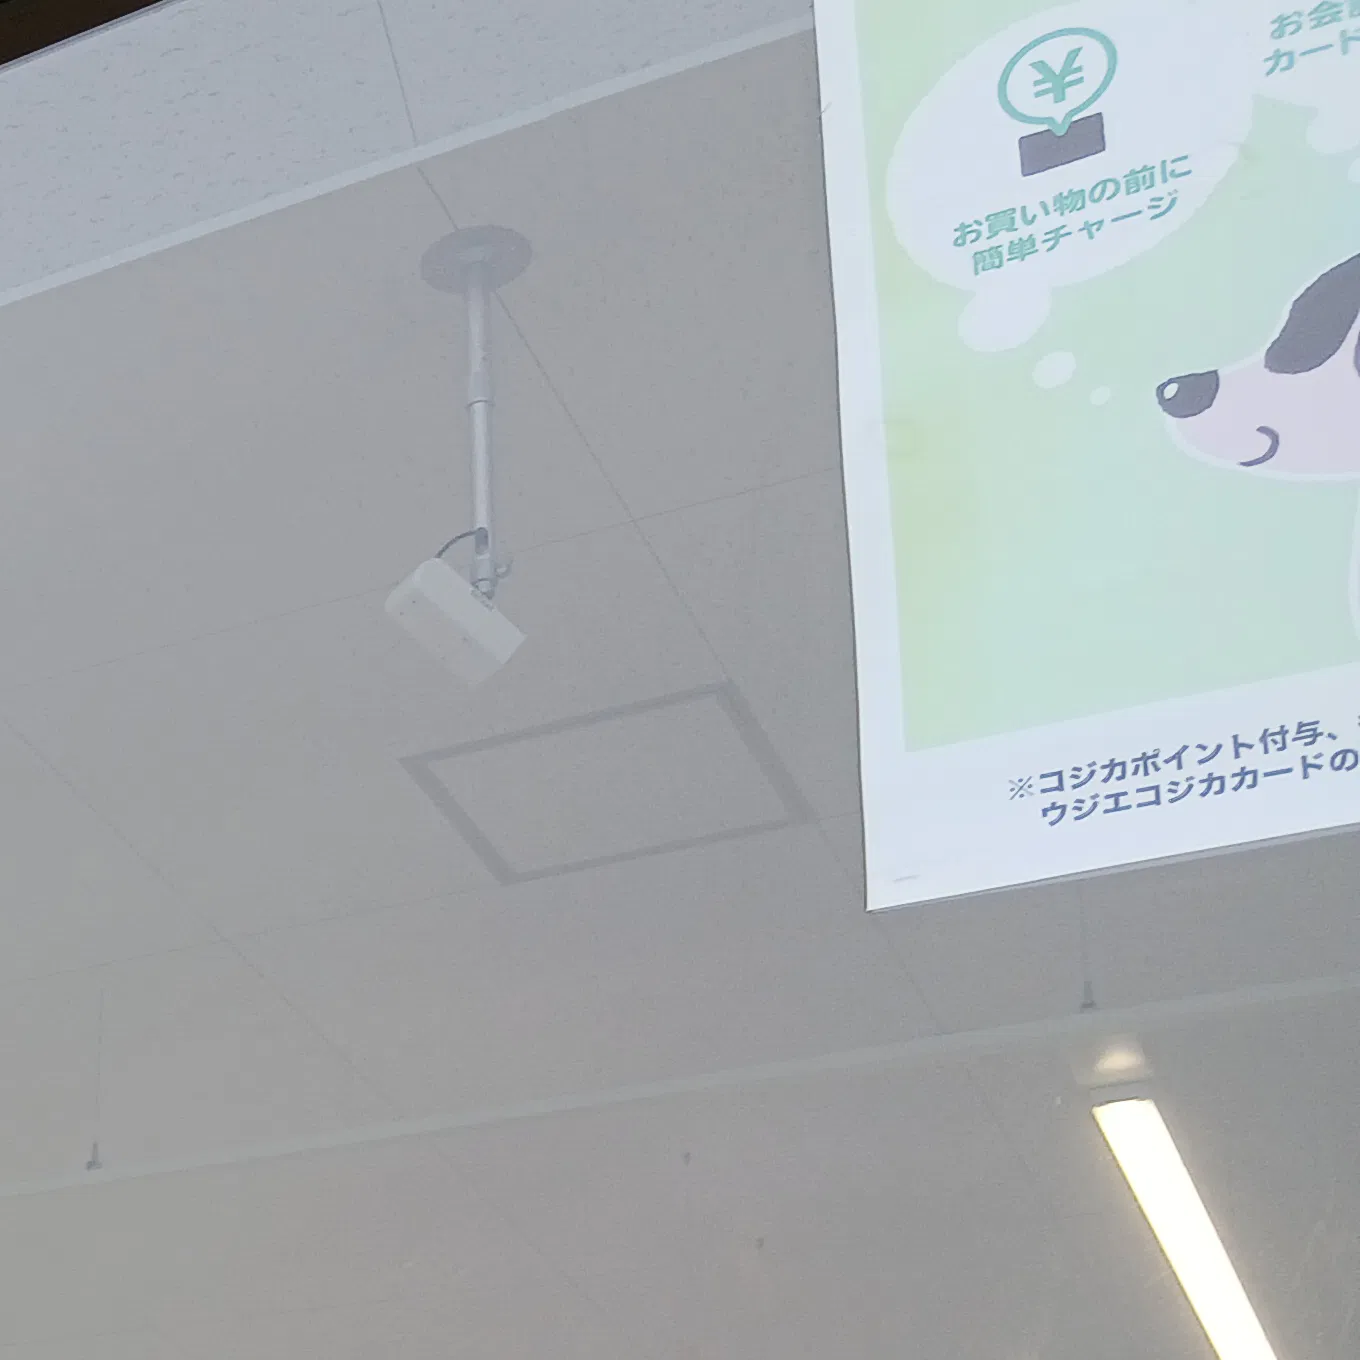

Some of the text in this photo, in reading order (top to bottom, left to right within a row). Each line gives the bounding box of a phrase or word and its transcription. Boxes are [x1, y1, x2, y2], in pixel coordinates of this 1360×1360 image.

[1270, 0, 1360, 39] お会
[952, 154, 1193, 249] お買い物の前に
[972, 190, 1180, 276] 簡単チャージ
[1041, 747, 1360, 827] ウジエコジカカードの
